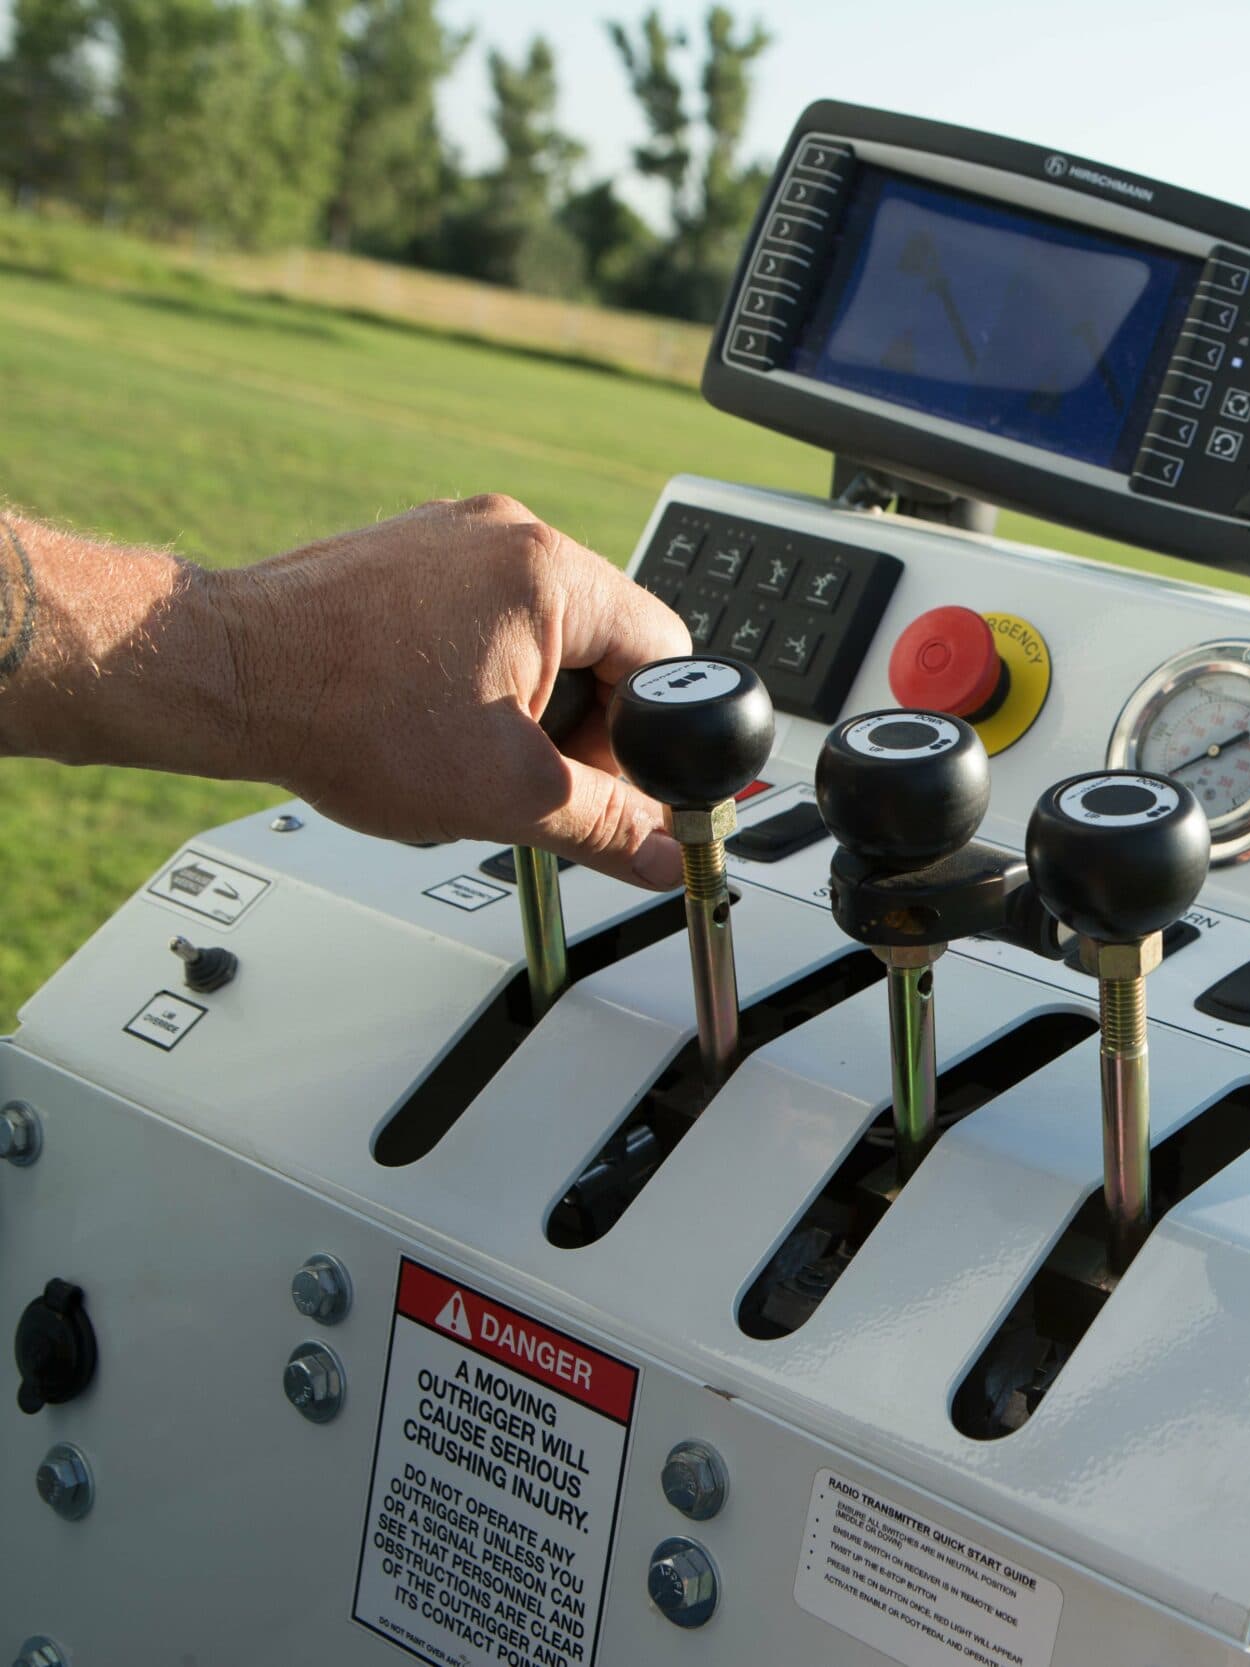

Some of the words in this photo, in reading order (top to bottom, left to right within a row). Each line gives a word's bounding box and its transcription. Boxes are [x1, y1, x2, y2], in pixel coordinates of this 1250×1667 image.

[1069, 165, 1153, 202] HIRSCHMANN
[986, 617, 1043, 664] RGENCY
[914, 715, 945, 725] DOWN
[1136, 778, 1167, 790] DOWN
[455, 1360, 469, 1384] A
[475, 1368, 556, 1426] MOVING
[480, 1313, 593, 1390] DANGER
[418, 1370, 535, 1444] OUTRIGGER
[542, 1430, 589, 1474] WILL
[419, 1399, 486, 1449] CAUSE
[490, 1435, 580, 1497] SERIOUS
[404, 1419, 506, 1488] CRUSHING
[512, 1475, 588, 1533] INJURY.
[404, 1463, 426, 1487] DO
[430, 1477, 462, 1505] NOT
[466, 1497, 537, 1547] OPERATE
[540, 1538, 575, 1566] ANY
[378, 1513, 407, 1540] SEE
[411, 1530, 448, 1562] THAT
[452, 1554, 544, 1618] PERSONNEL
[549, 1610, 584, 1638] AND
[383, 1495, 405, 1518] OR
[408, 1509, 418, 1527] A
[423, 1516, 477, 1559] SIGNAL
[482, 1549, 546, 1596] PERSON
[550, 1587, 585, 1618] CAN
[391, 1478, 478, 1537] OUTRIGGER
[483, 1528, 544, 1573] UNLESS
[550, 1563, 583, 1594] YOU
[828, 1477, 859, 1499] RADIO
[862, 1494, 930, 1535] TRANSMITTER
[933, 1530, 964, 1552] QUICK
[967, 1548, 1001, 1571] START
[1003, 1566, 1036, 1589] GUIDE
[830, 1541, 851, 1556] TWIST
[852, 1552, 863, 1561] UP
[864, 1558, 878, 1570] THE
[906, 1581, 937, 1602] BUTTON
[832, 1525, 861, 1545] ENSURE
[862, 1540, 891, 1560] SWITCH
[891, 1556, 903, 1566] ON
[904, 1562, 940, 1585] RECEIVER
[942, 1581, 949, 1590] IS
[950, 1586, 958, 1595] IN
[995, 1609, 1016, 1626] MODE
[835, 1509, 864, 1528] (MIDDLE
[865, 1524, 876, 1535] OR
[877, 1530, 902, 1549] DOWN)
[837, 1501, 866, 1521] ENSURE
[867, 1517, 879, 1528] ALL
[882, 1524, 919, 1547] SWITCHES
[920, 1544, 935, 1556] ARE
[936, 1551, 945, 1561] IN
[945, 1556, 978, 1578] NEUTRAL
[981, 1574, 1016, 1598] POSITION
[374, 1532, 490, 1608] OBSTRUCTIONS
[494, 1601, 527, 1629] ARE
[530, 1620, 583, 1661] CLEAR
[382, 1558, 403, 1578] OF
[406, 1570, 435, 1599] THE
[439, 1590, 529, 1652] OUTRIGGER
[533, 1644, 567, 1667] AND
[395, 1585, 418, 1610] ITS
[422, 1601, 494, 1652] CONTACT
[824, 1573, 858, 1596] ACTIVATE
[859, 1591, 886, 1610] ENABLE
[888, 1607, 899, 1617] OR
[900, 1613, 920, 1628] FOOT
[921, 1624, 944, 1642] PEDAL
[946, 1638, 962, 1651] AND
[826, 1556, 850, 1574] PRESS
[852, 1570, 865, 1582] THE
[867, 1578, 878, 1589] ON
[879, 1584, 908, 1605] BUTTON
[933, 1613, 949, 1626] RED
[950, 1622, 972, 1638] LIGHT
[973, 1634, 989, 1648] WILL
[992, 1645, 1022, 1664] APPEAR
